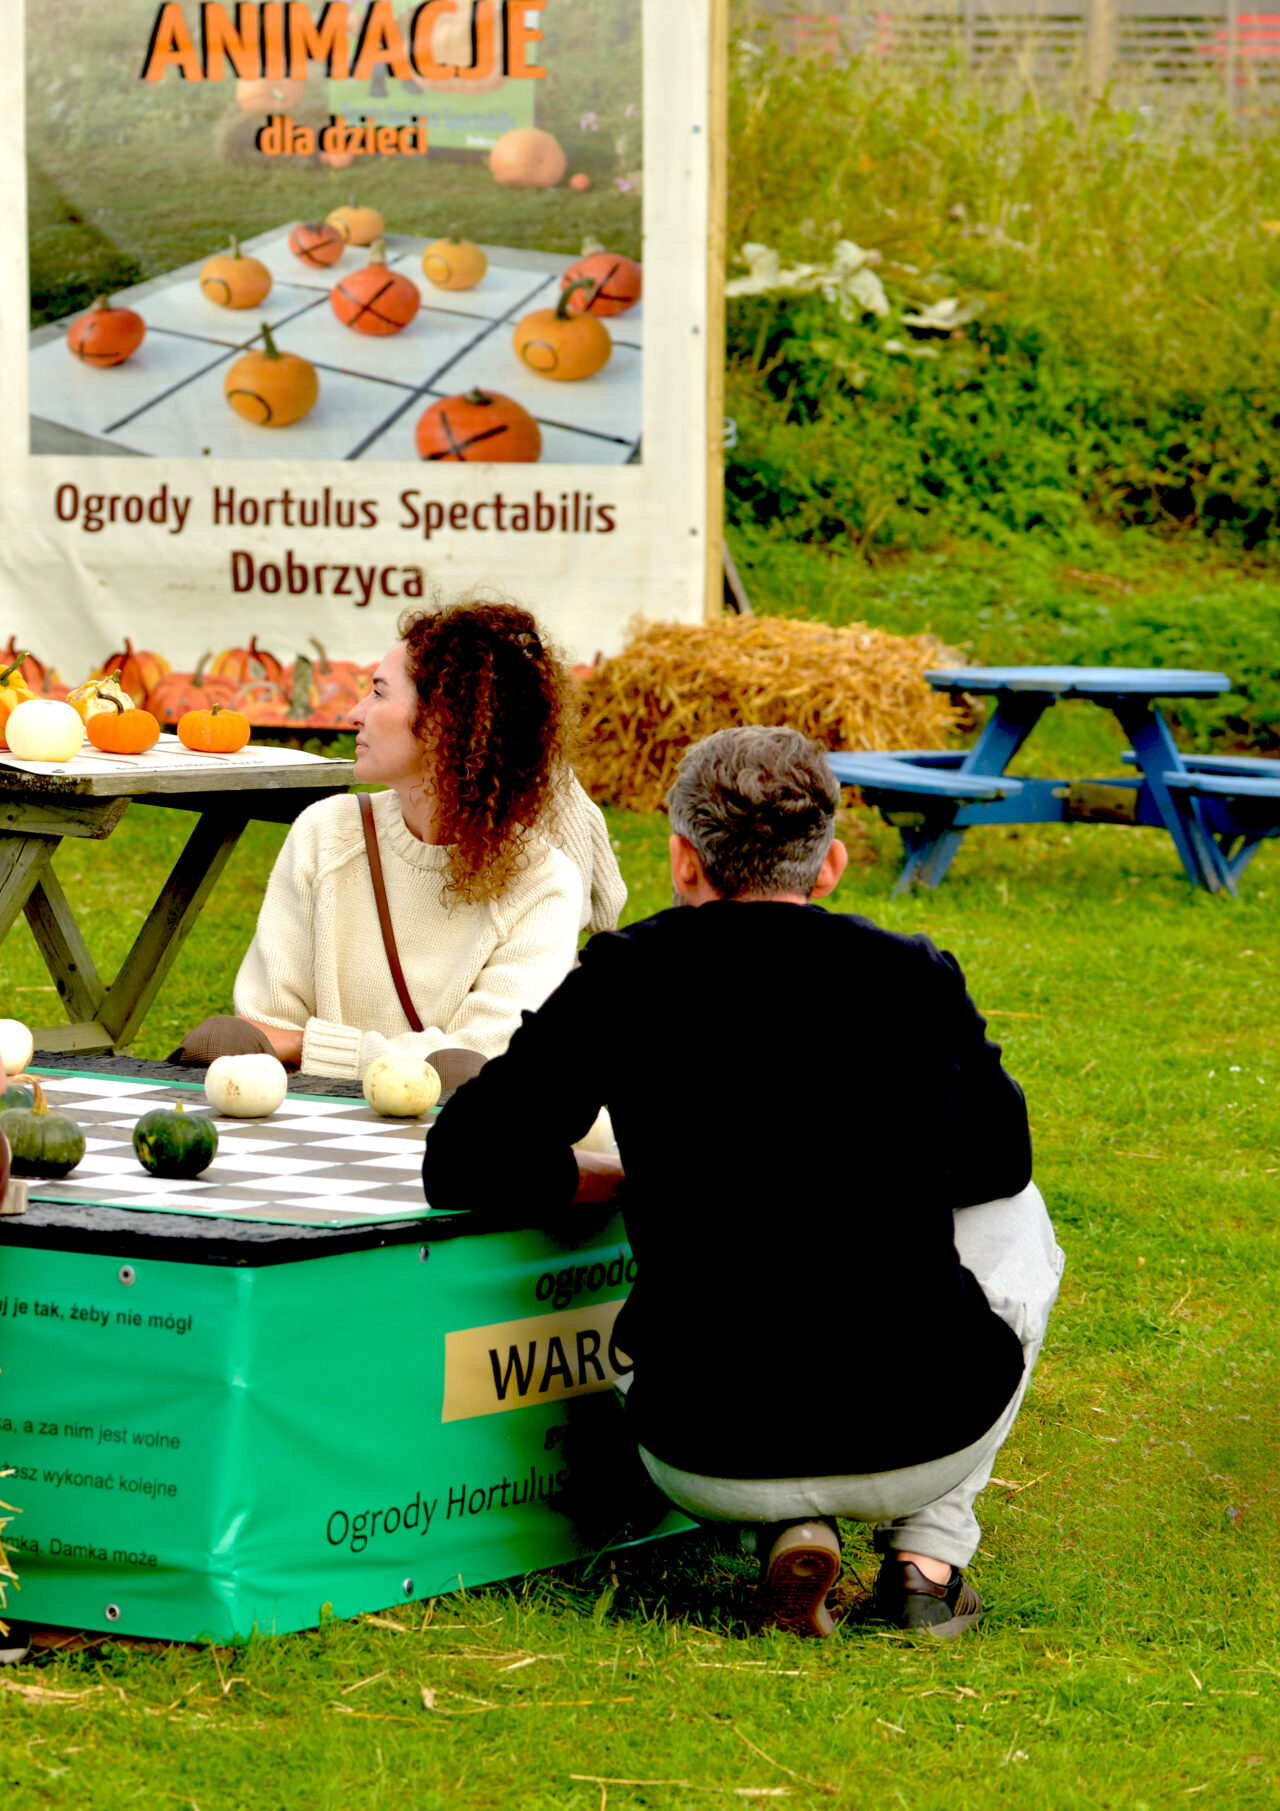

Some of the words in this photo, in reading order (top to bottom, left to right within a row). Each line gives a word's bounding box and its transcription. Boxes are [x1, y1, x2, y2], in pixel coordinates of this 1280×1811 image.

[138, 0, 547, 82] ANIMACJE
[256, 114, 316, 155] dla
[320, 114, 428, 155] dzieci
[55, 483, 191, 534] Ogrody
[213, 486, 379, 528] Hortulus
[400, 490, 617, 540] Spectabilis
[231, 550, 425, 606] Dobrzyca
[12, 1297, 28, 1318] je
[34, 1301, 65, 1321] tak,
[70, 1303, 110, 1328] żeby
[116, 1309, 143, 1327] nie
[148, 1312, 192, 1335] mógł
[23, 1420, 34, 1433] a
[39, 1422, 58, 1436] za
[64, 1422, 94, 1440] nim
[97, 1424, 127, 1445] jest
[132, 1431, 181, 1450] wolne
[42, 1468, 114, 1489] wykonać
[119, 1474, 178, 1500] kolejne
[326, 1491, 437, 1553] Ogrody
[446, 1466, 569, 1520] Hortulus
[50, 1537, 107, 1562] Damka
[113, 1548, 158, 1567] może
